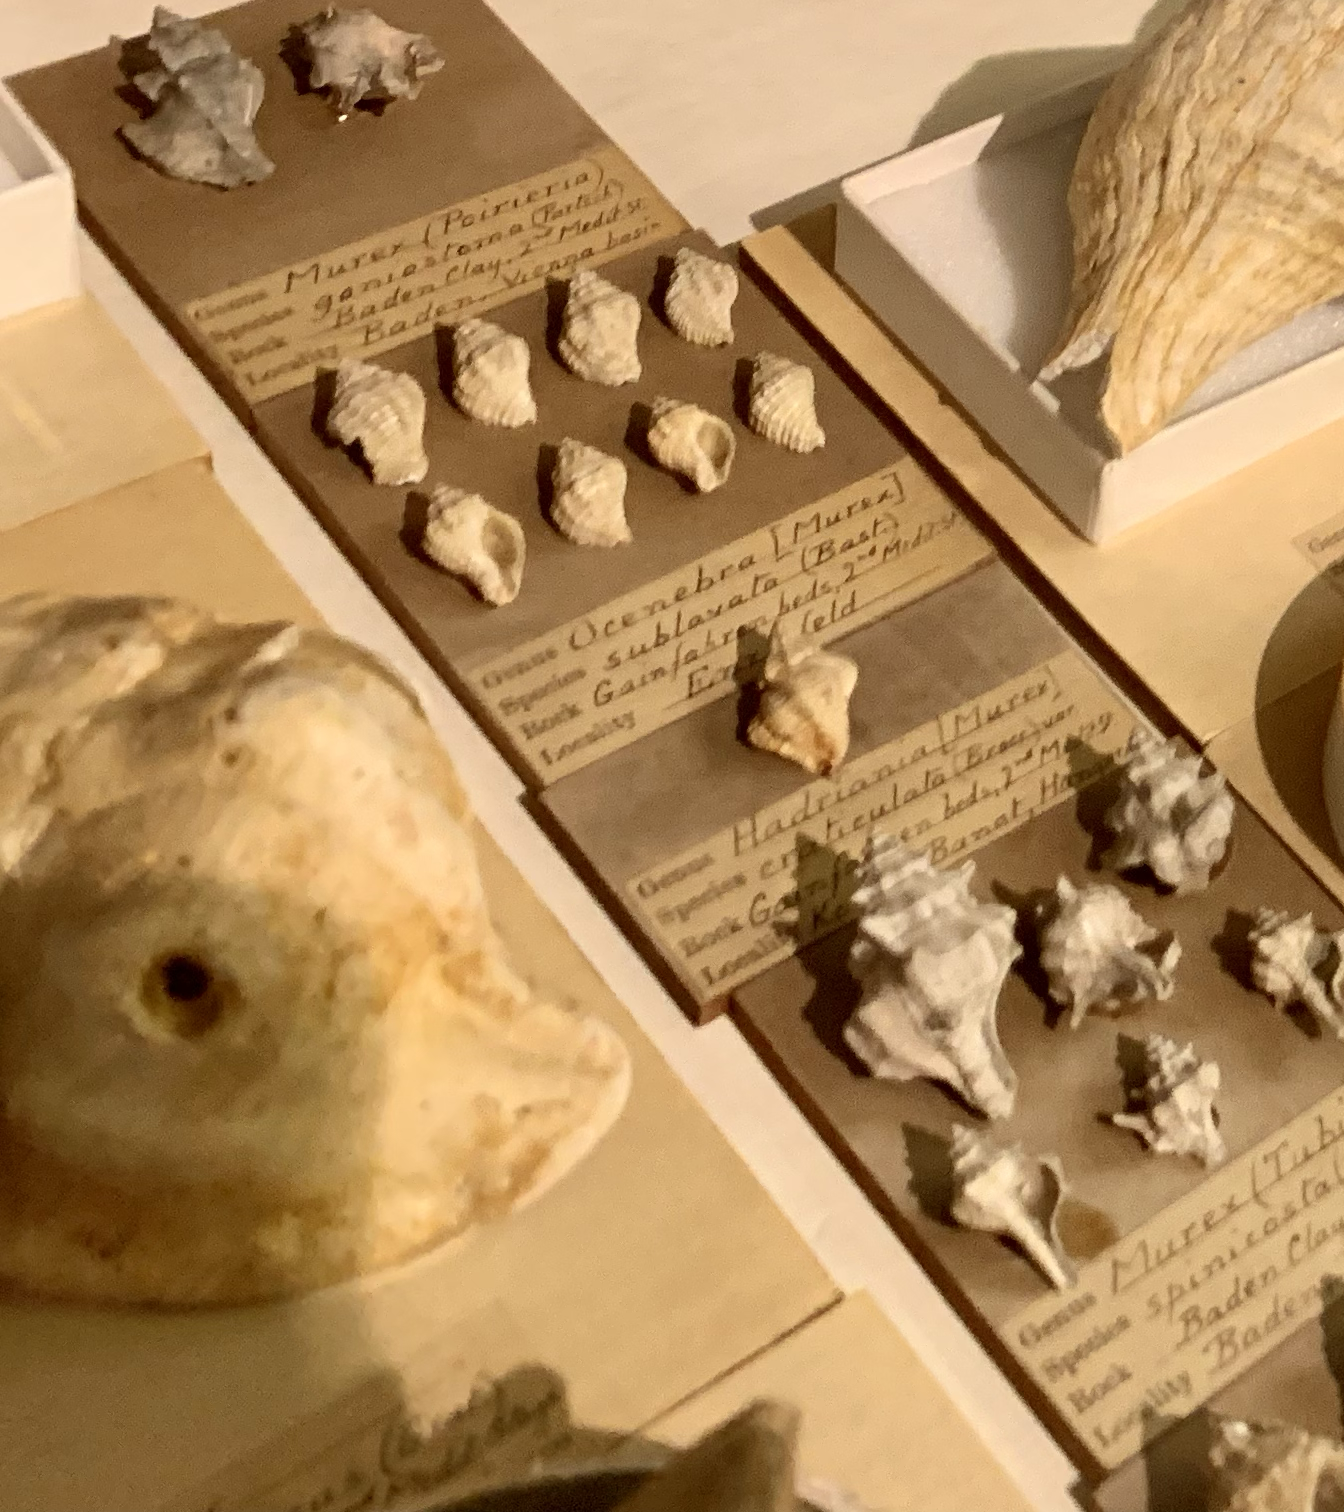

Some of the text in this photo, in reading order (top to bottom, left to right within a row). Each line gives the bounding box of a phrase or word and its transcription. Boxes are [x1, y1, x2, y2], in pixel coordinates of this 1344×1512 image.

[283, 238, 402, 296] Murex
[1108, 1193, 1237, 1297] Murex
[1175, 1262, 1274, 1350] Baden
